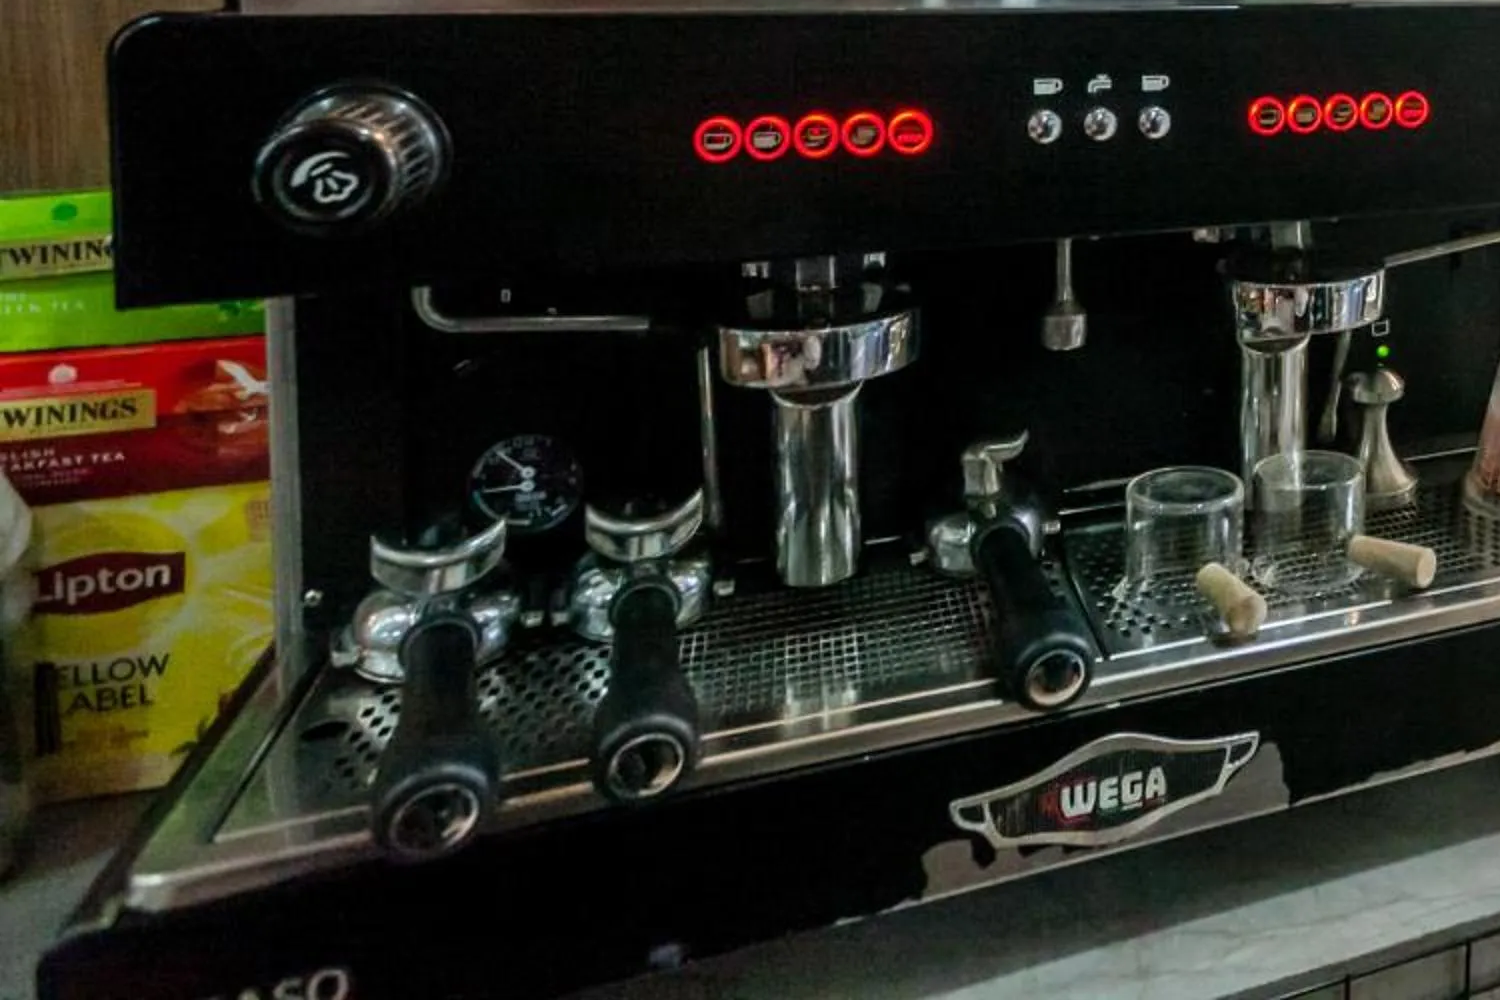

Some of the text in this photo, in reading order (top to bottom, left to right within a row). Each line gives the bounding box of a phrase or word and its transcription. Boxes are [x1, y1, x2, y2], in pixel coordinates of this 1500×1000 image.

[0, 397, 137, 428] WININGS
[57, 653, 169, 687] ELLOW
[65, 684, 154, 714] ABEL
[1061, 766, 1166, 817] WEGA
